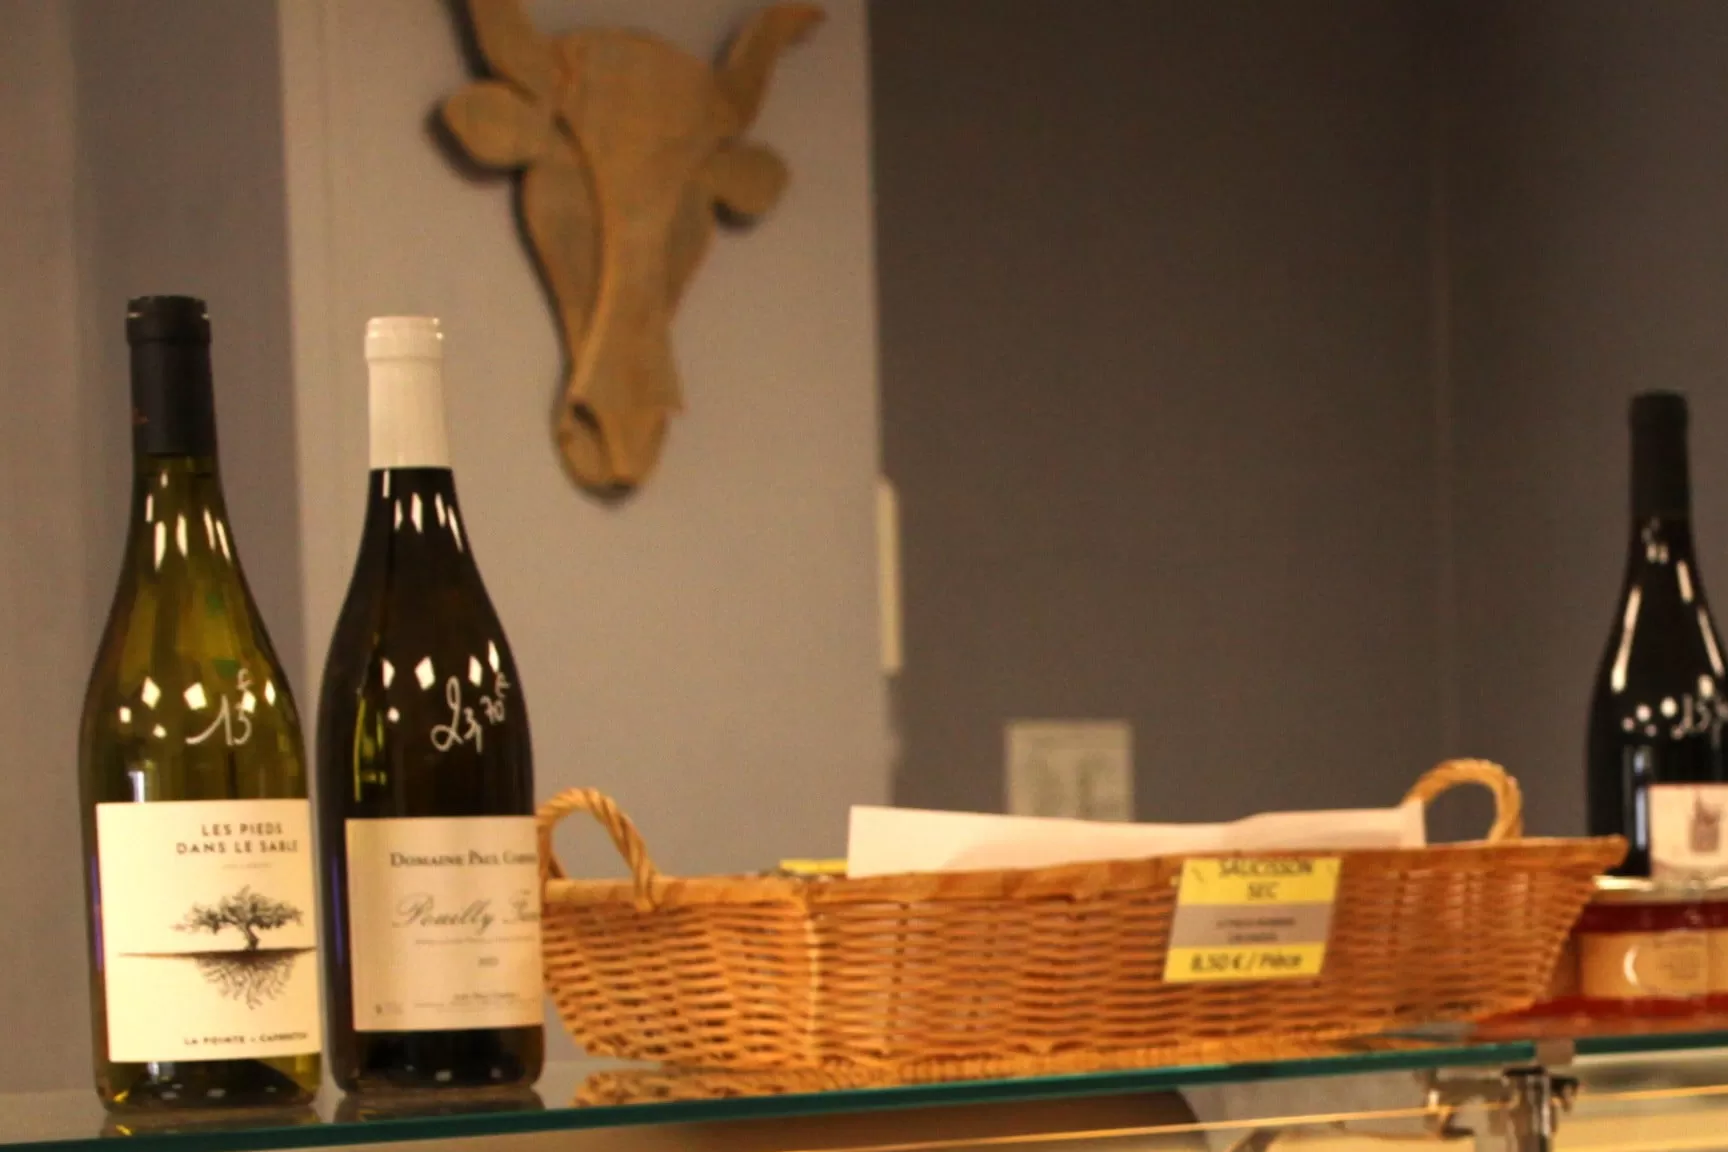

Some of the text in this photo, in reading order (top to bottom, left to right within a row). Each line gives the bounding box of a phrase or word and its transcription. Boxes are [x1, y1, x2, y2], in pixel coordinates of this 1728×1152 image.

[201, 821, 284, 837] LES PIEDS
[176, 839, 298, 855] DANS LE SABLE
